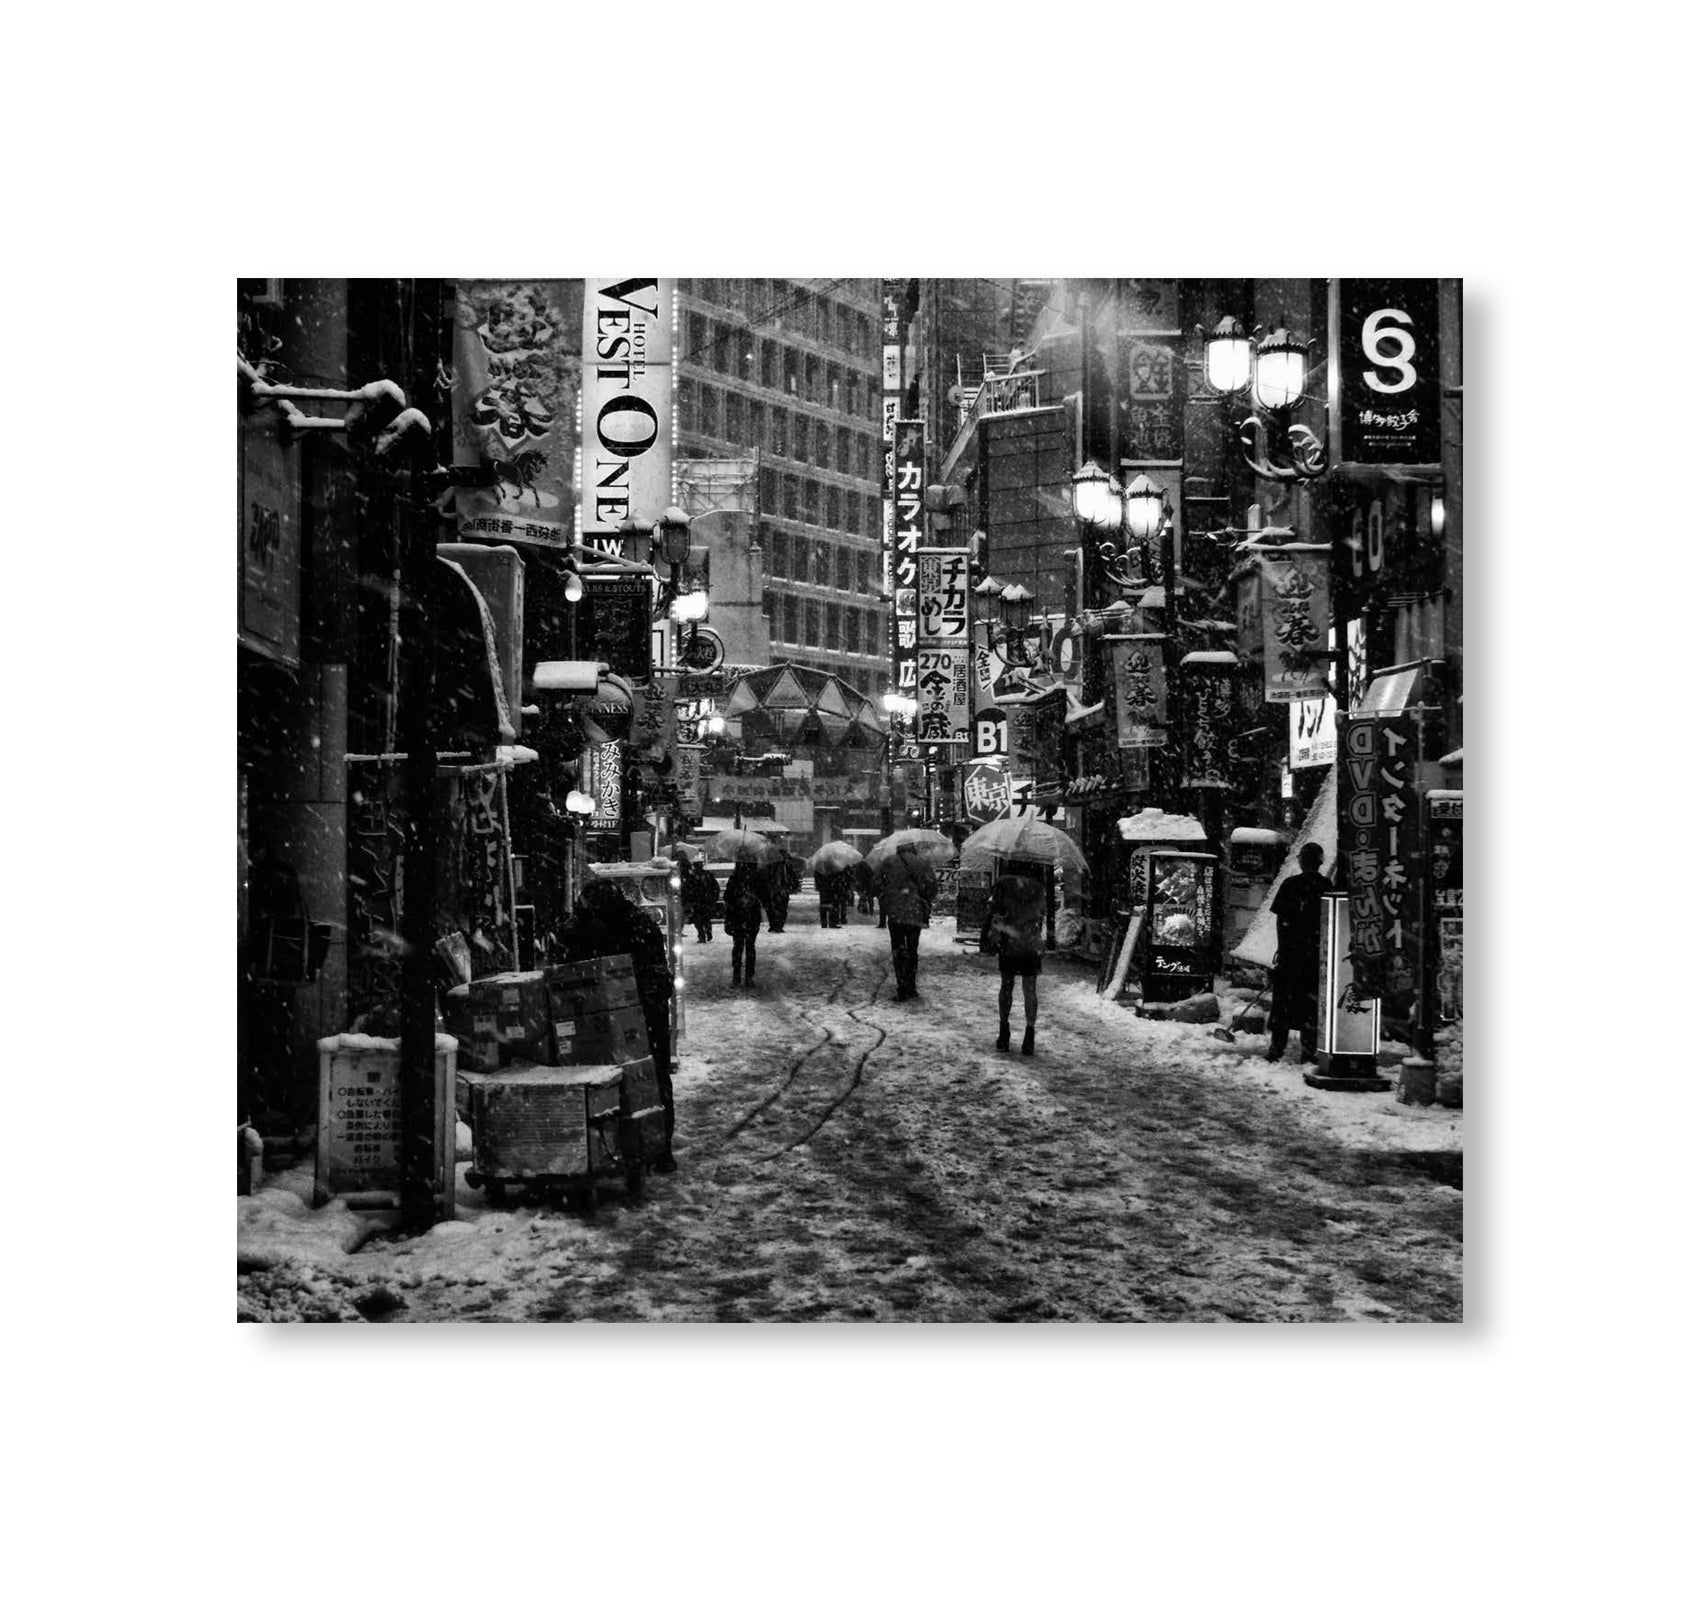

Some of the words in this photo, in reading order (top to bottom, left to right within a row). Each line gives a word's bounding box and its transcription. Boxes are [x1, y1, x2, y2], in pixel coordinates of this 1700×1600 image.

[633, 323, 647, 382] HOTEL
[598, 395, 657, 524] ONE
[920, 596, 942, 636] めし
[941, 556, 967, 636] チカラ
[920, 653, 952, 670] 270
[953, 664, 967, 706] 居酒屋
[920, 670, 952, 740] 金の蔵
[977, 720, 1008, 754] B1
[601, 742, 621, 818] みみかき
[963, 776, 1008, 813] 東京
